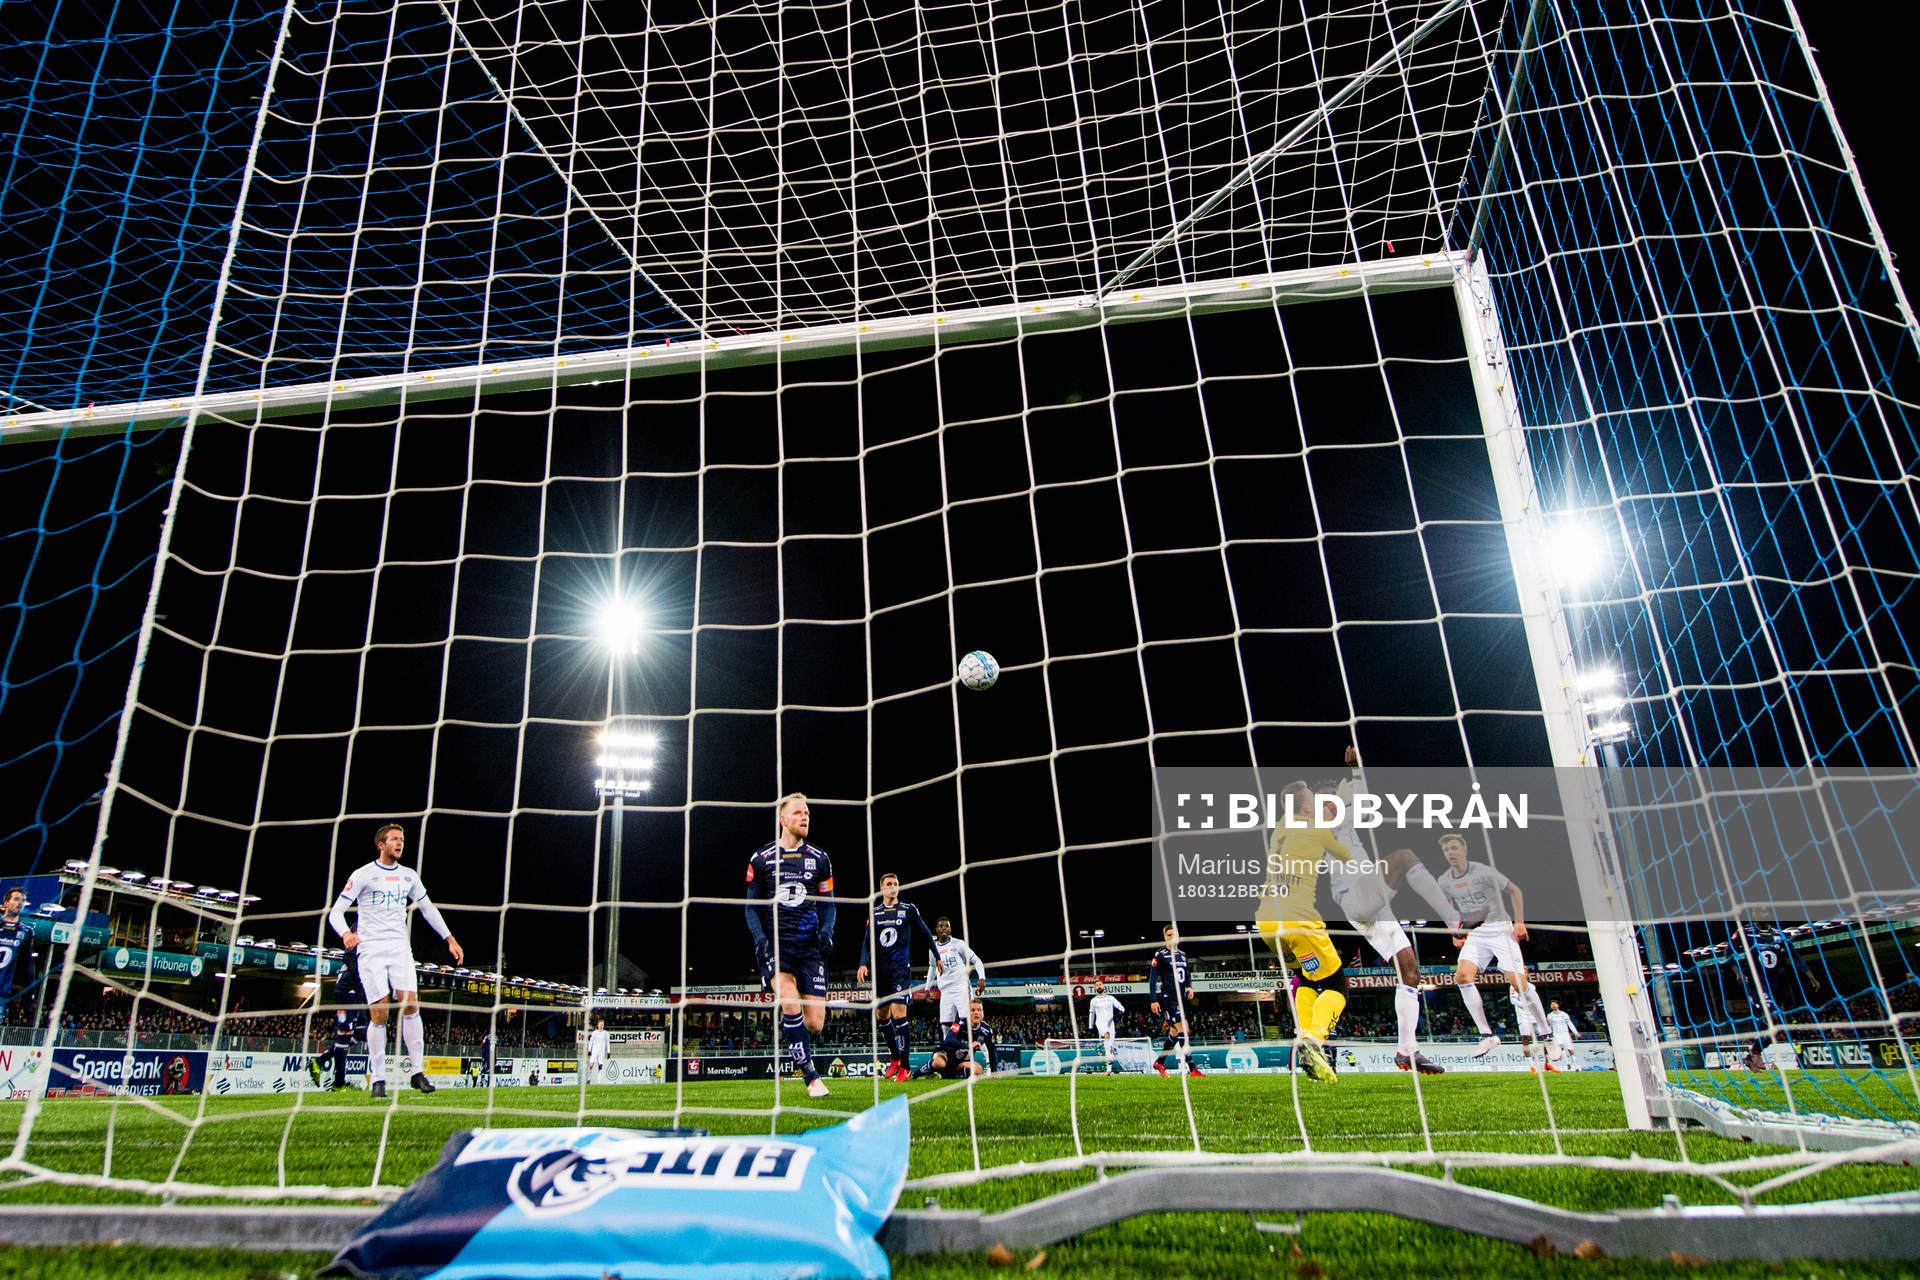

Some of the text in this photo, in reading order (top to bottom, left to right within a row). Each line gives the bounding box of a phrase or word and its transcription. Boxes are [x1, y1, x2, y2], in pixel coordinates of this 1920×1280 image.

[153, 956, 189, 972] Tribunen
[1349, 976, 1398, 988] STRAND
[1474, 972, 1563, 985] ENTREENØR
[1567, 971, 1584, 981] AS
[1026, 987, 1053, 995] LEASING
[1089, 985, 1132, 994] TBUNEN
[592, 997, 626, 1005] TINGVOLL
[706, 993, 751, 1003] STRAND
[754, 993, 761, 1002] &
[826, 991, 874, 1001] TREPREN
[609, 1032, 642, 1042] angset
[1369, 1054, 1378, 1064] Vi
[1507, 1053, 1545, 1063] Nore
[1803, 1044, 1873, 1065] NEAS NEAS
[71, 1053, 163, 1084] SpareBank
[345, 1060, 365, 1071] ADCOM
[109, 1084, 160, 1097] NORDVEST
